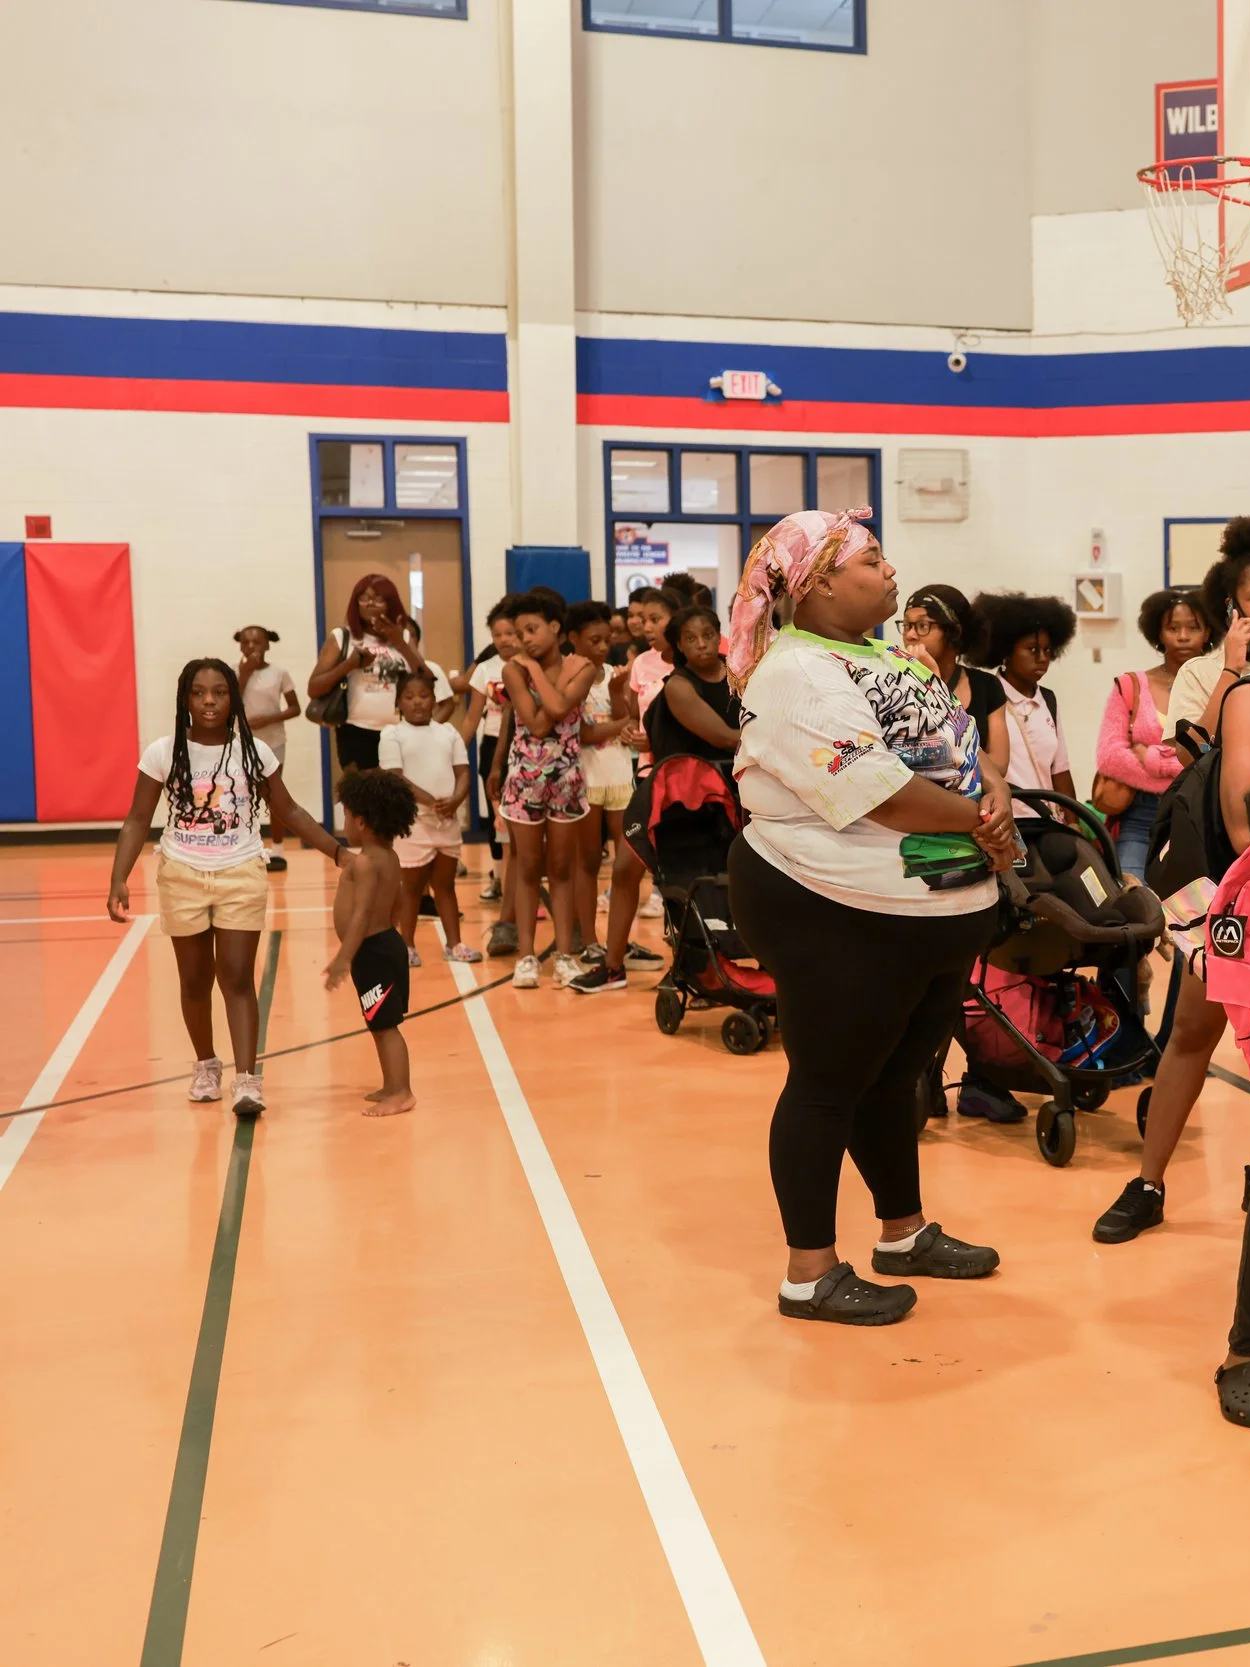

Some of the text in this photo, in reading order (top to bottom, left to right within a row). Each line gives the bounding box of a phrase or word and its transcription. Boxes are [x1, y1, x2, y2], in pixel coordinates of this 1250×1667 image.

[730, 373, 759, 395] EXIT
[174, 831, 239, 847] SUPERIOR
[360, 983, 385, 1011] NIKE
